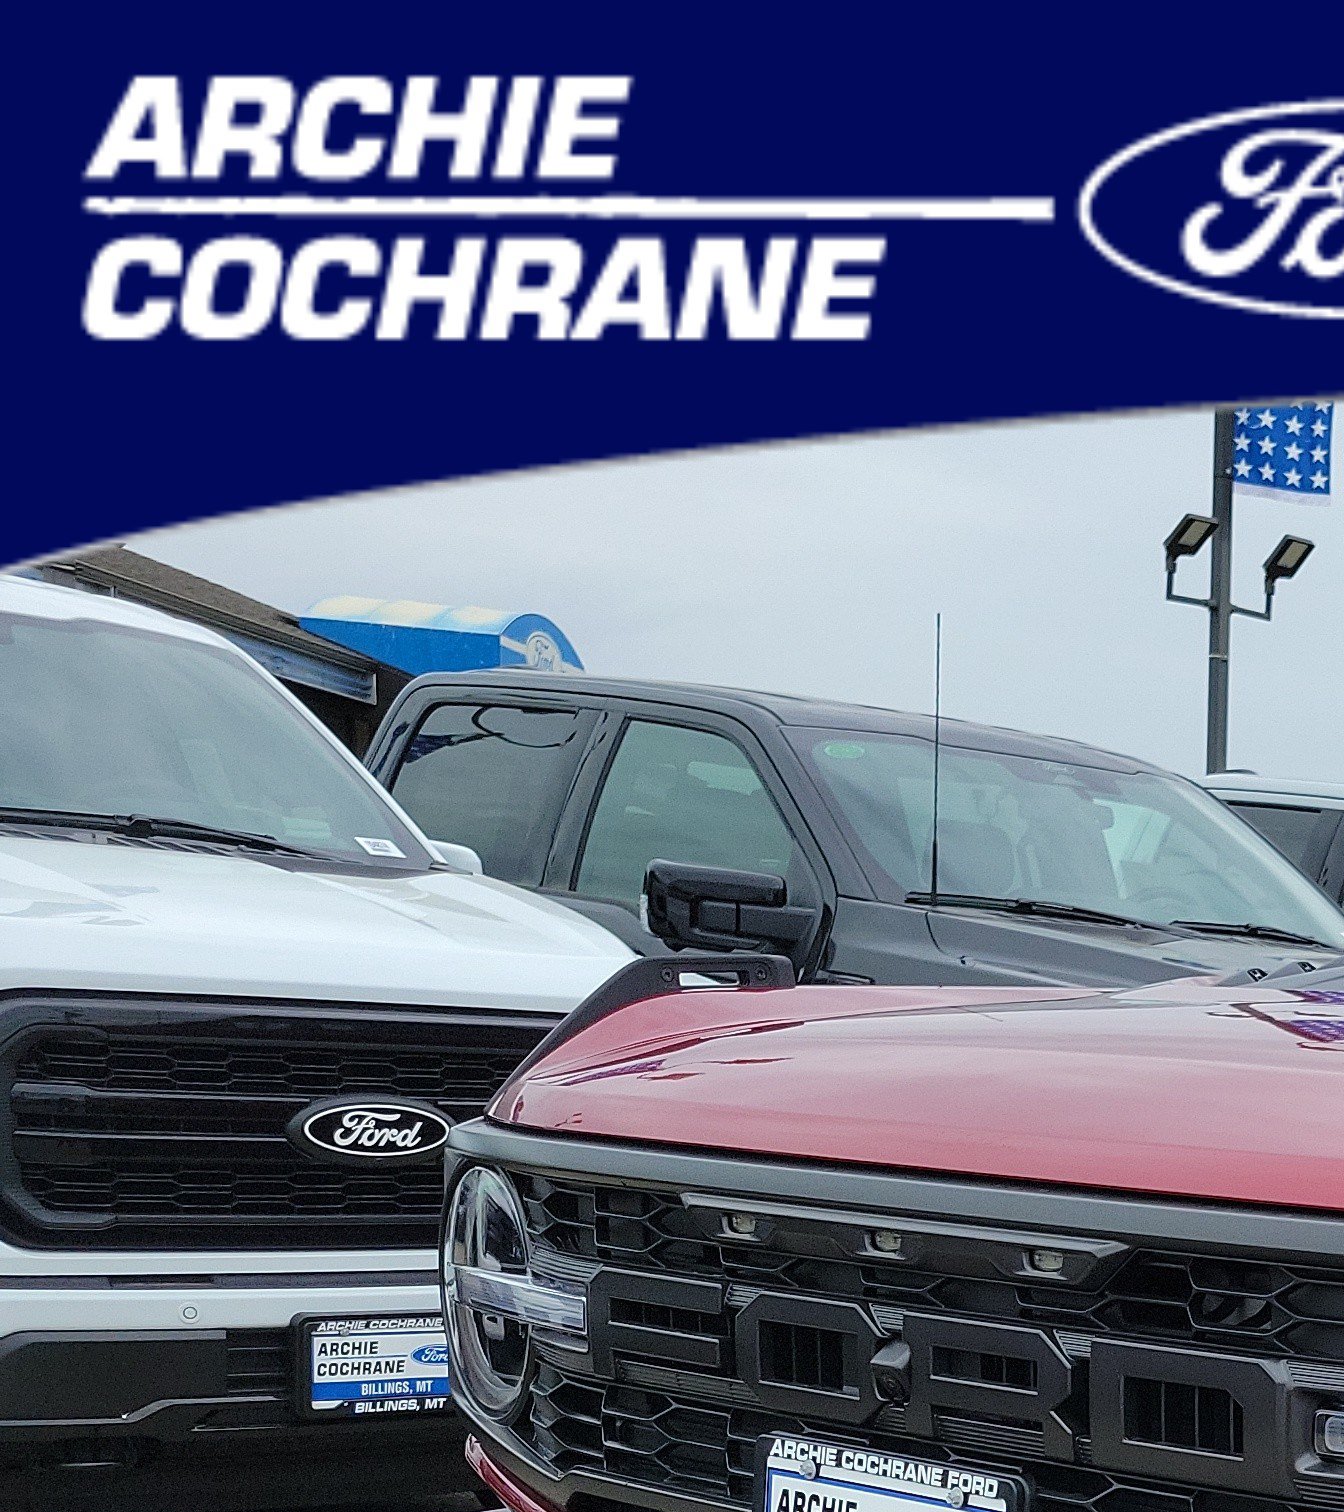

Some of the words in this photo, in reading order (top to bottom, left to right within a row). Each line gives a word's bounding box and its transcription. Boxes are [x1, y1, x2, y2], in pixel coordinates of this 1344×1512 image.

[333, 1109, 422, 1149] Ford
[317, 1320, 366, 1331] ARCHIE
[370, 1318, 443, 1329] COCHRANE
[318, 1341, 378, 1356] ARCHIE
[317, 1360, 405, 1377] COCHRANE
[587, 1265, 1295, 1488] FORD
[361, 1381, 413, 1395] BILLINGS,
[416, 1380, 433, 1392] MT
[355, 1399, 420, 1413] BILLINGS,
[424, 1398, 447, 1409] MT
[770, 1439, 837, 1466] ARCHIE
[841, 1451, 942, 1487] COCHRANE
[947, 1471, 998, 1498] FORD
